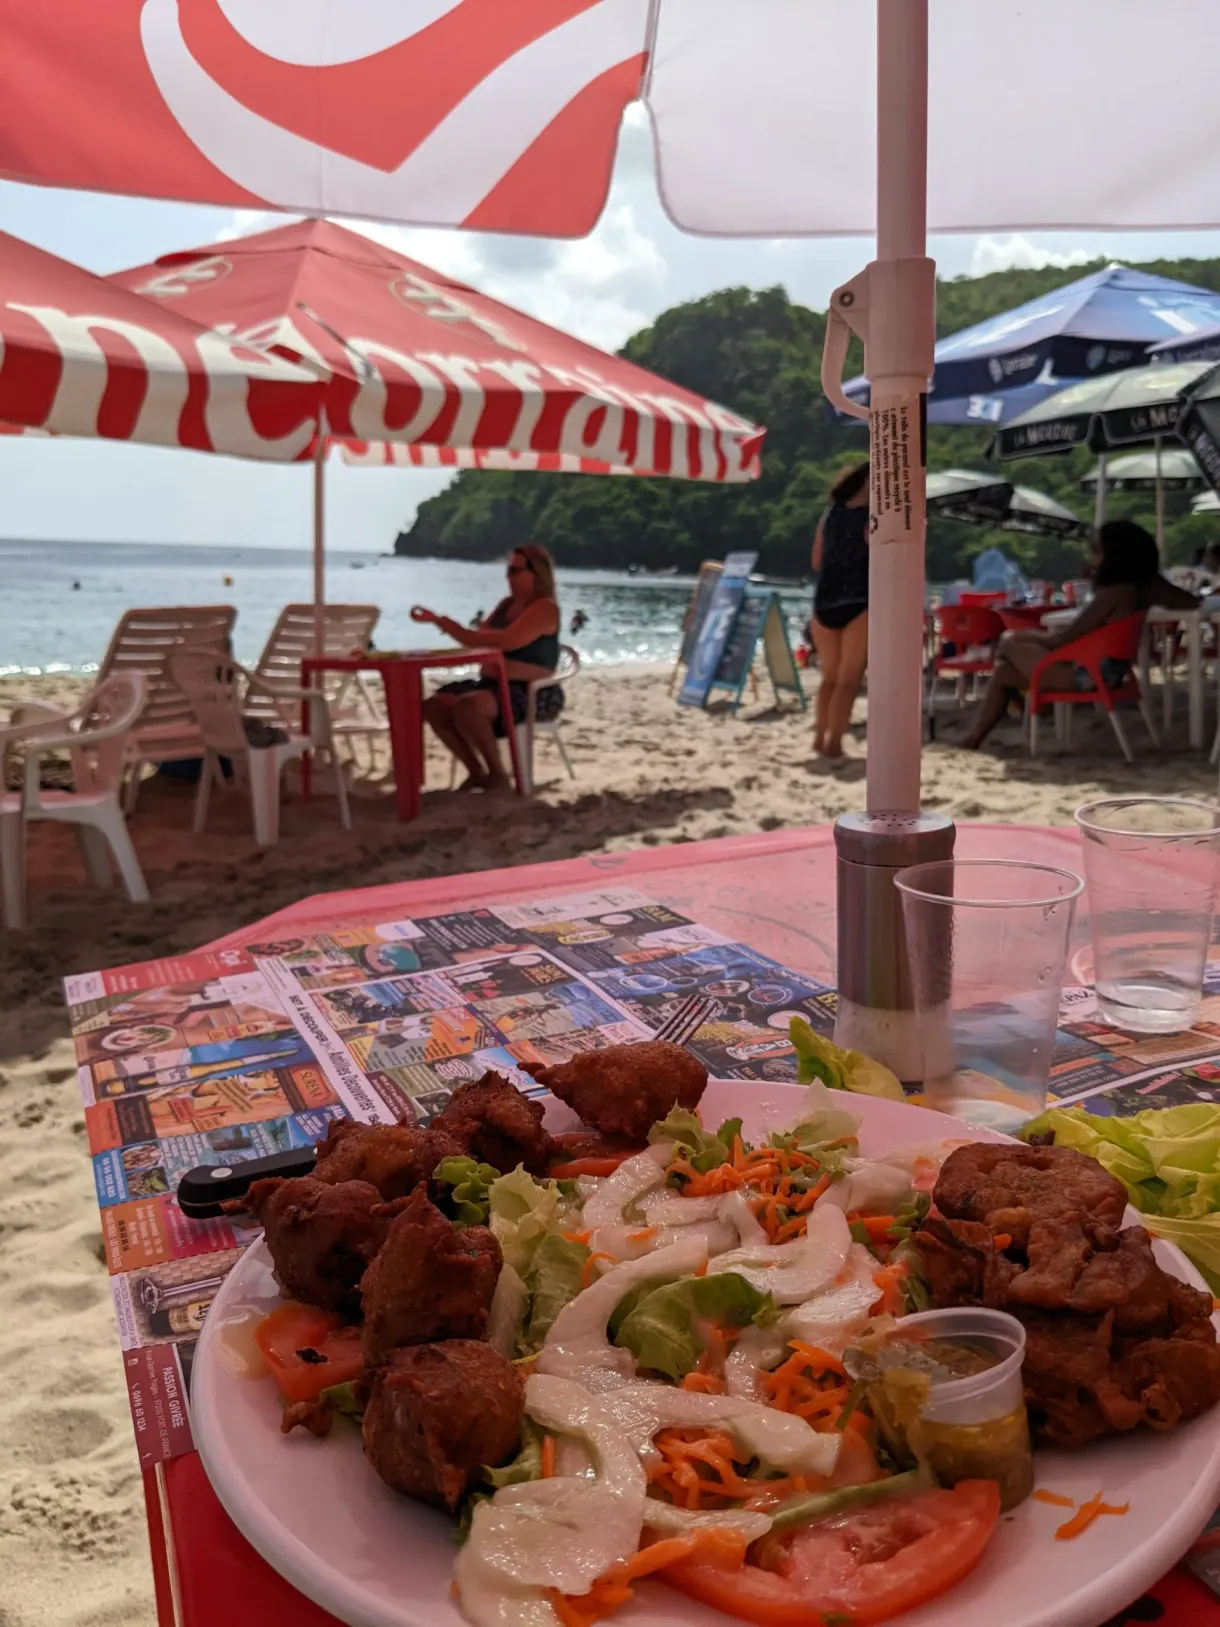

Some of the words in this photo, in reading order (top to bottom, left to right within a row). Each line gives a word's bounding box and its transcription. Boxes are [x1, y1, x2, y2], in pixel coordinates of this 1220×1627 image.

[162, 1366, 177, 1398] PASSION
[131, 1389, 143, 1407] 0696
[136, 1416, 148, 1431] 1234
[168, 1398, 186, 1428] GIVRÉE
